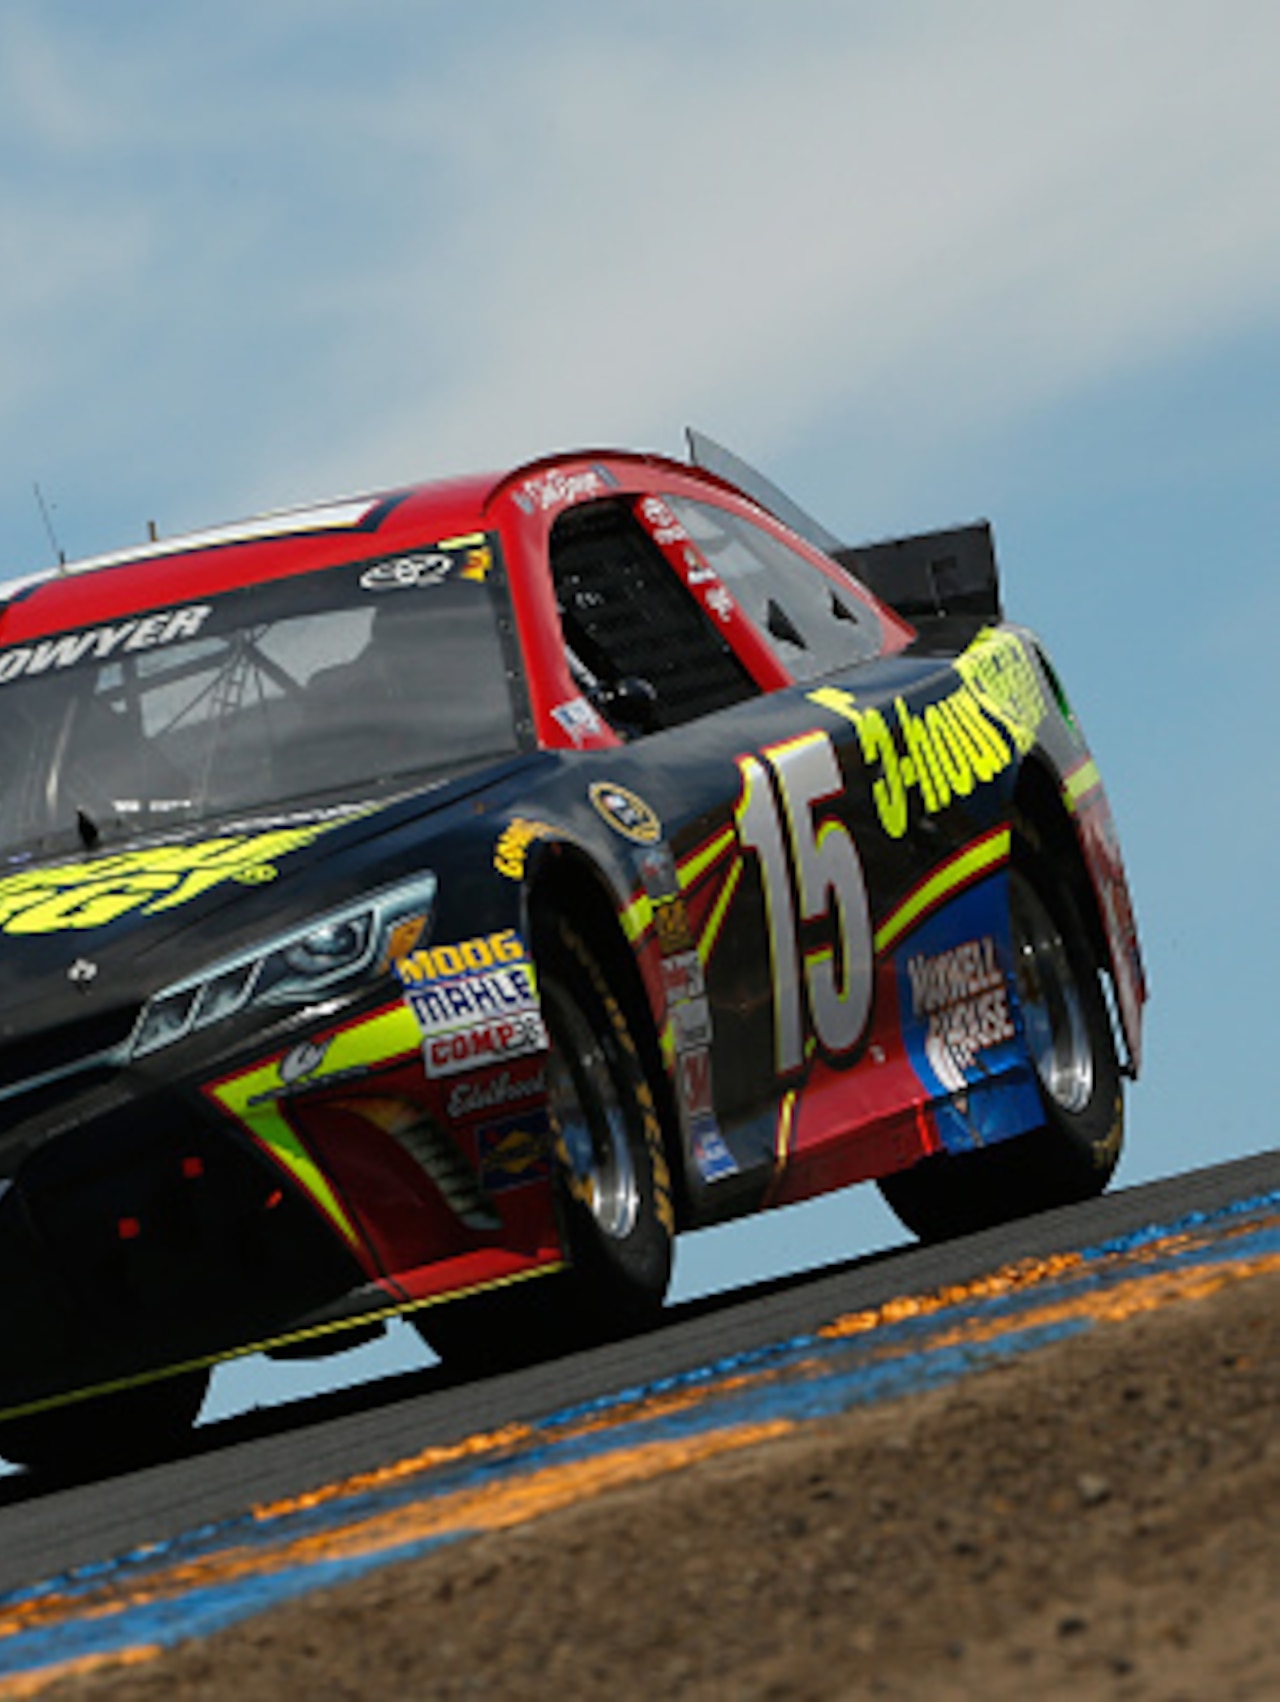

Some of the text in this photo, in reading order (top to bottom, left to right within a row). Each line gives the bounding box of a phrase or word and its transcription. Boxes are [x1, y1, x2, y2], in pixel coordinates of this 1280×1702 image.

[733, 727, 873, 1076] 15
[396, 928, 524, 984] MOOG
[908, 936, 1004, 1018] MAXWELL
[411, 970, 532, 1026] MAHLE
[938, 986, 1015, 1056] HOUSE
[431, 1023, 516, 1067] COMP
